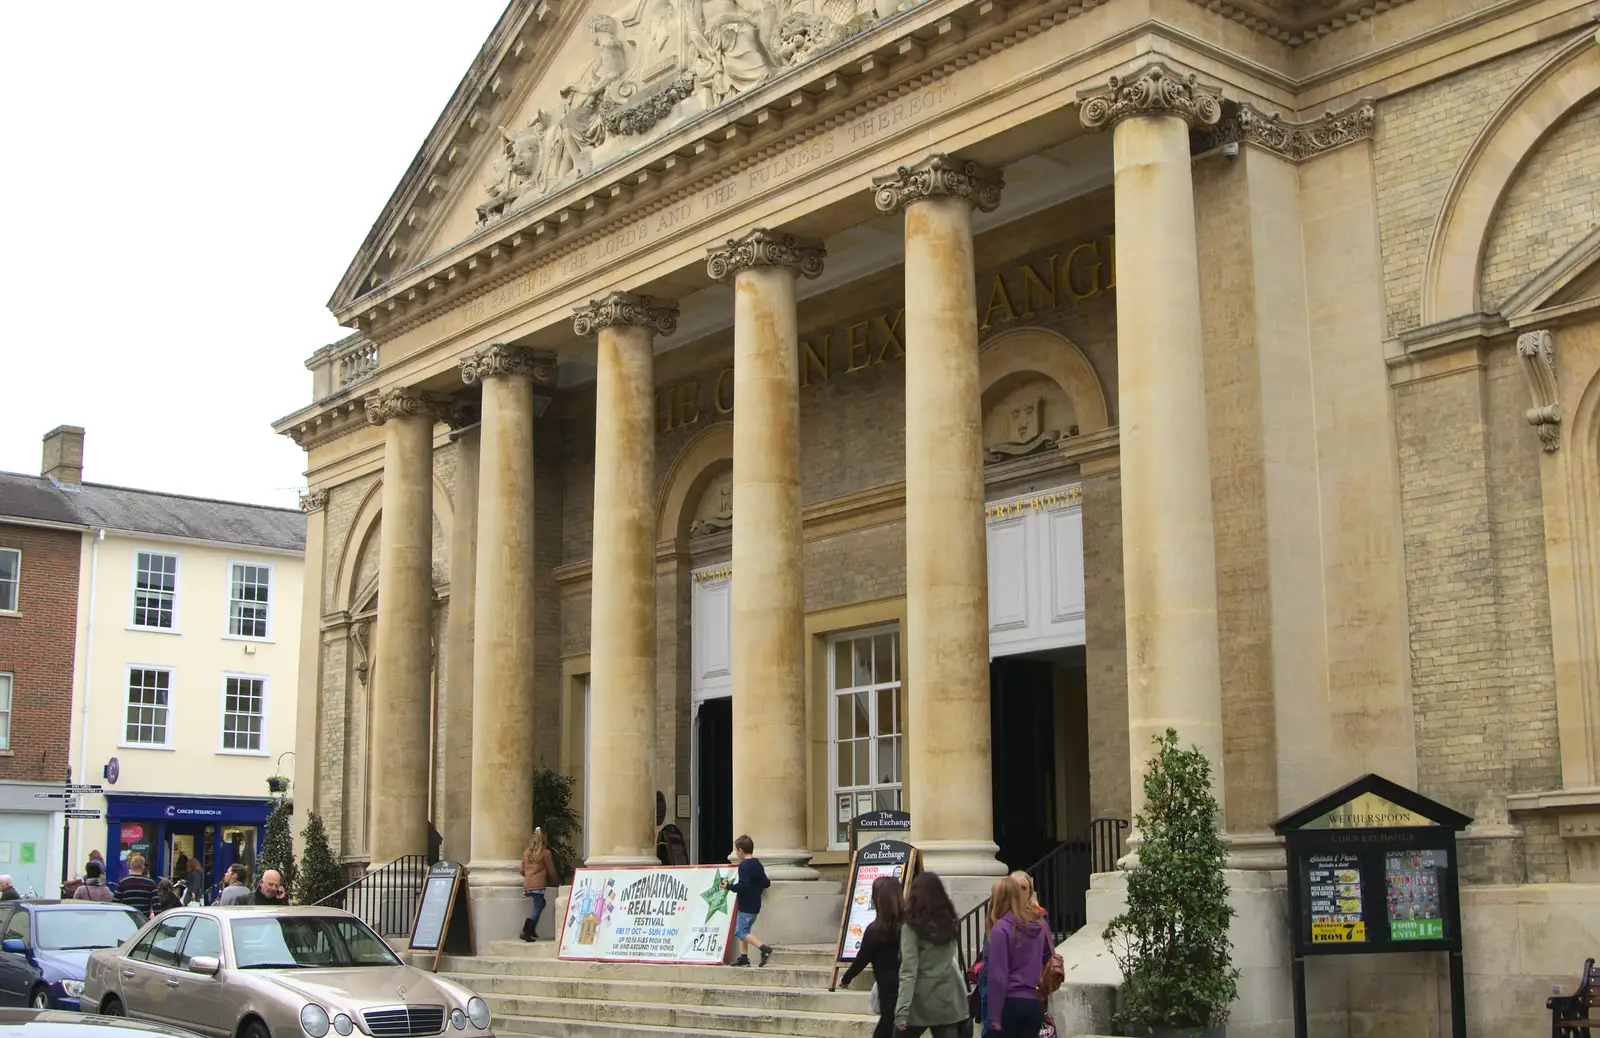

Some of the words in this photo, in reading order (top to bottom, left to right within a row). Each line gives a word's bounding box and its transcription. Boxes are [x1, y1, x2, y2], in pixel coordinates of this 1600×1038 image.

[491, 278, 534, 308] EARTH
[561, 252, 588, 274] THE
[596, 222, 648, 260] LORD'S
[656, 204, 691, 232] AND
[702, 183, 738, 209] THE
[749, 136, 835, 190] FULNESS
[987, 499, 1024, 519] FREE
[1329, 812, 1411, 824] WETHERSPOON
[1331, 834, 1358, 843] CORN
[1361, 832, 1415, 843] EXCHANGE
[863, 852, 878, 860] Corn
[878, 851, 905, 860] Exchange
[620, 873, 689, 901] INTERNATIONAL
[627, 900, 677, 915] REAL-ALE
[634, 917, 665, 926] FESTIVAL
[648, 928, 661, 936] SUN
[666, 928, 679, 936] NOV
[1343, 923, 1356, 941] 7
[1392, 931, 1419, 939] UNTIL
[1419, 923, 1434, 936] 11
[692, 933, 719, 952] £2.15
